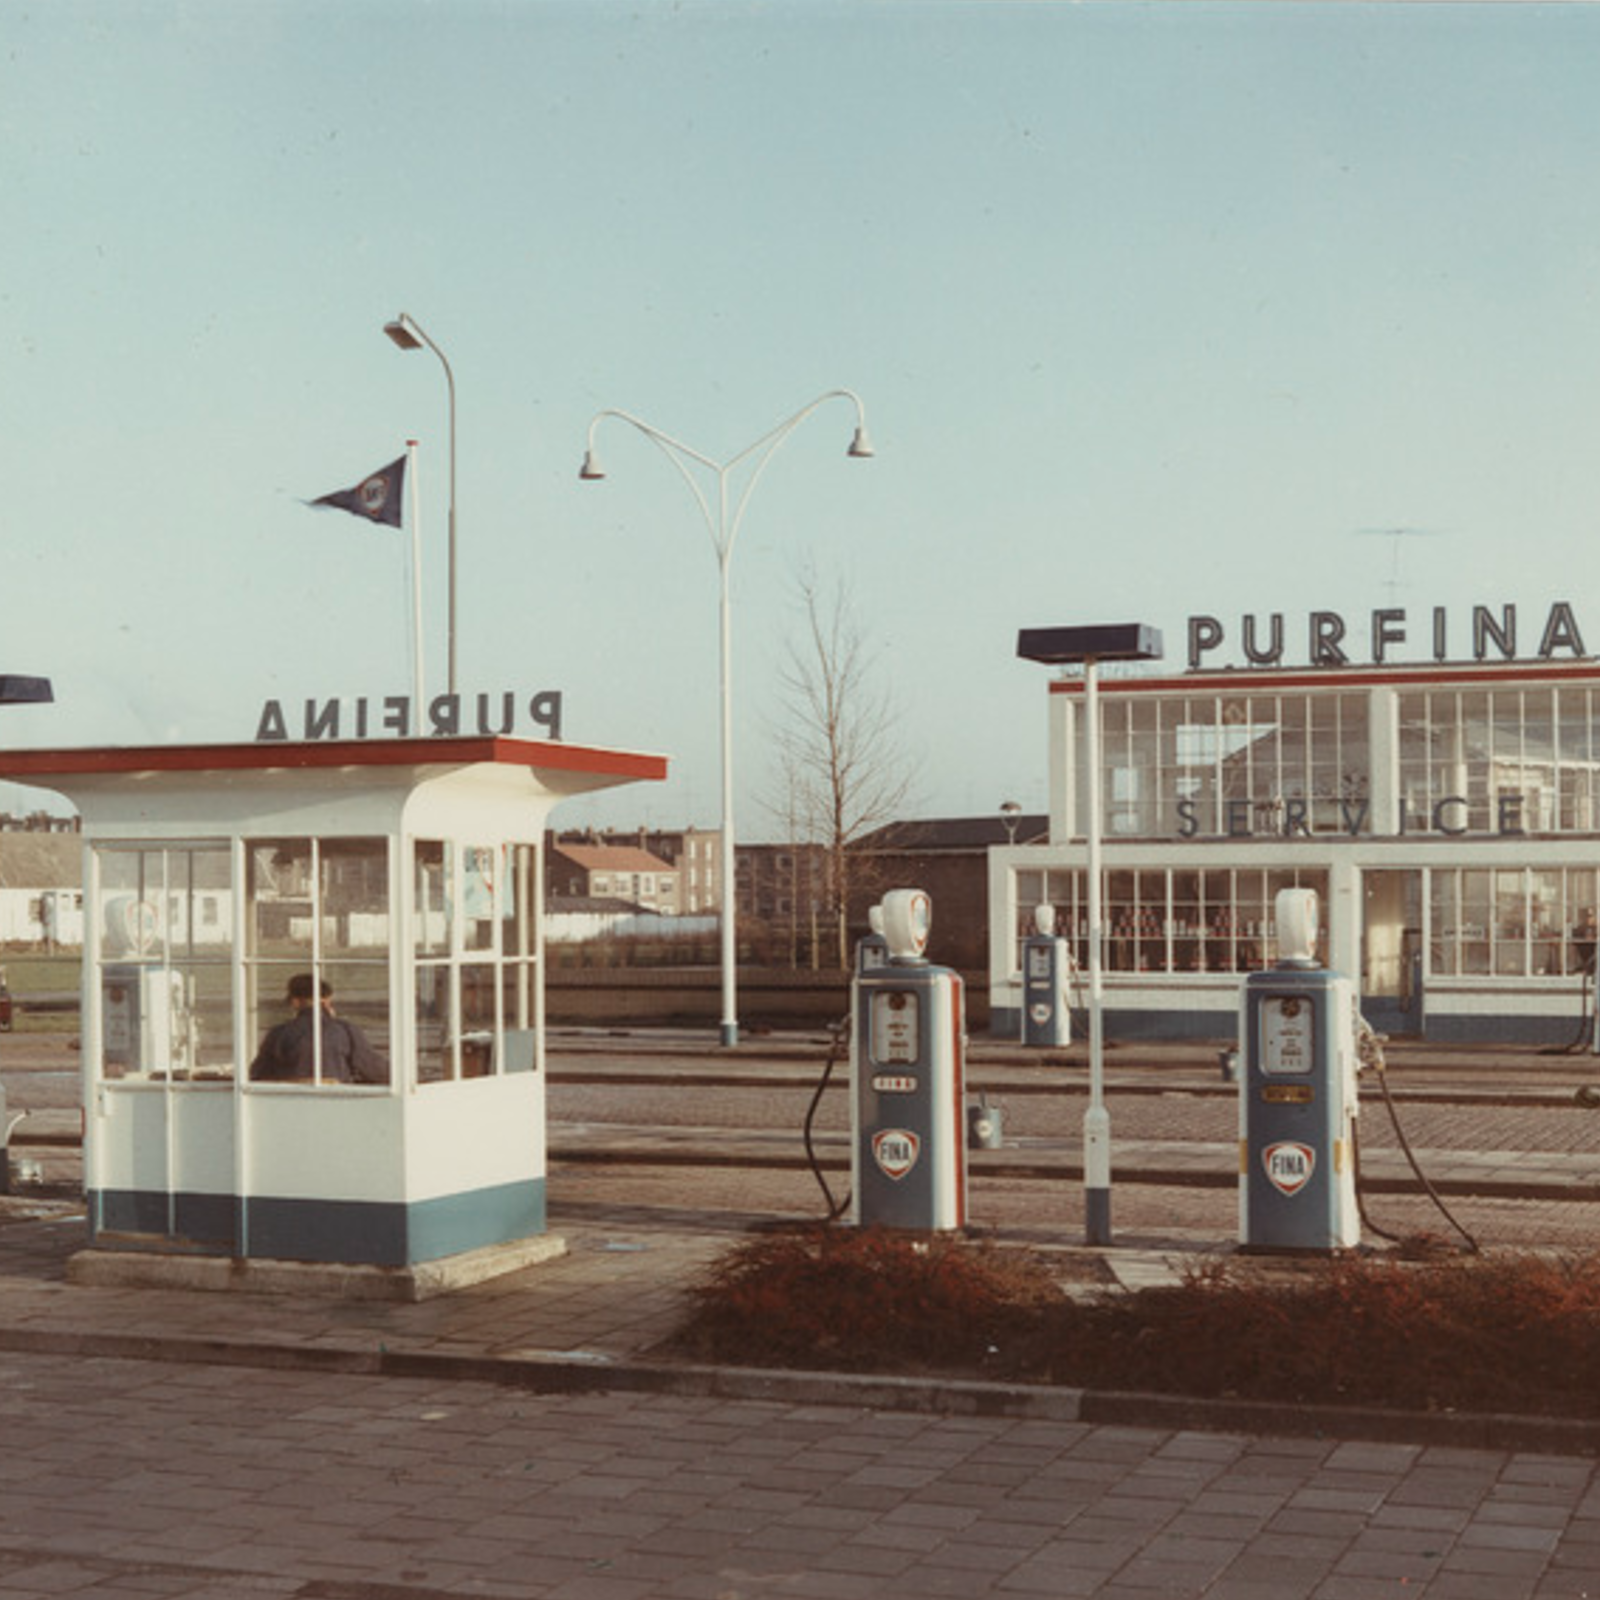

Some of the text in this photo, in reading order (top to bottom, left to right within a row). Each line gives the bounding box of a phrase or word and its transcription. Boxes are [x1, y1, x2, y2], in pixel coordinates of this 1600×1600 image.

[1187, 601, 1585, 668] PURFINA
[1175, 795, 1526, 838] SERVICE
[880, 1141, 910, 1161] FINA
[1271, 1154, 1305, 1175] FINA
